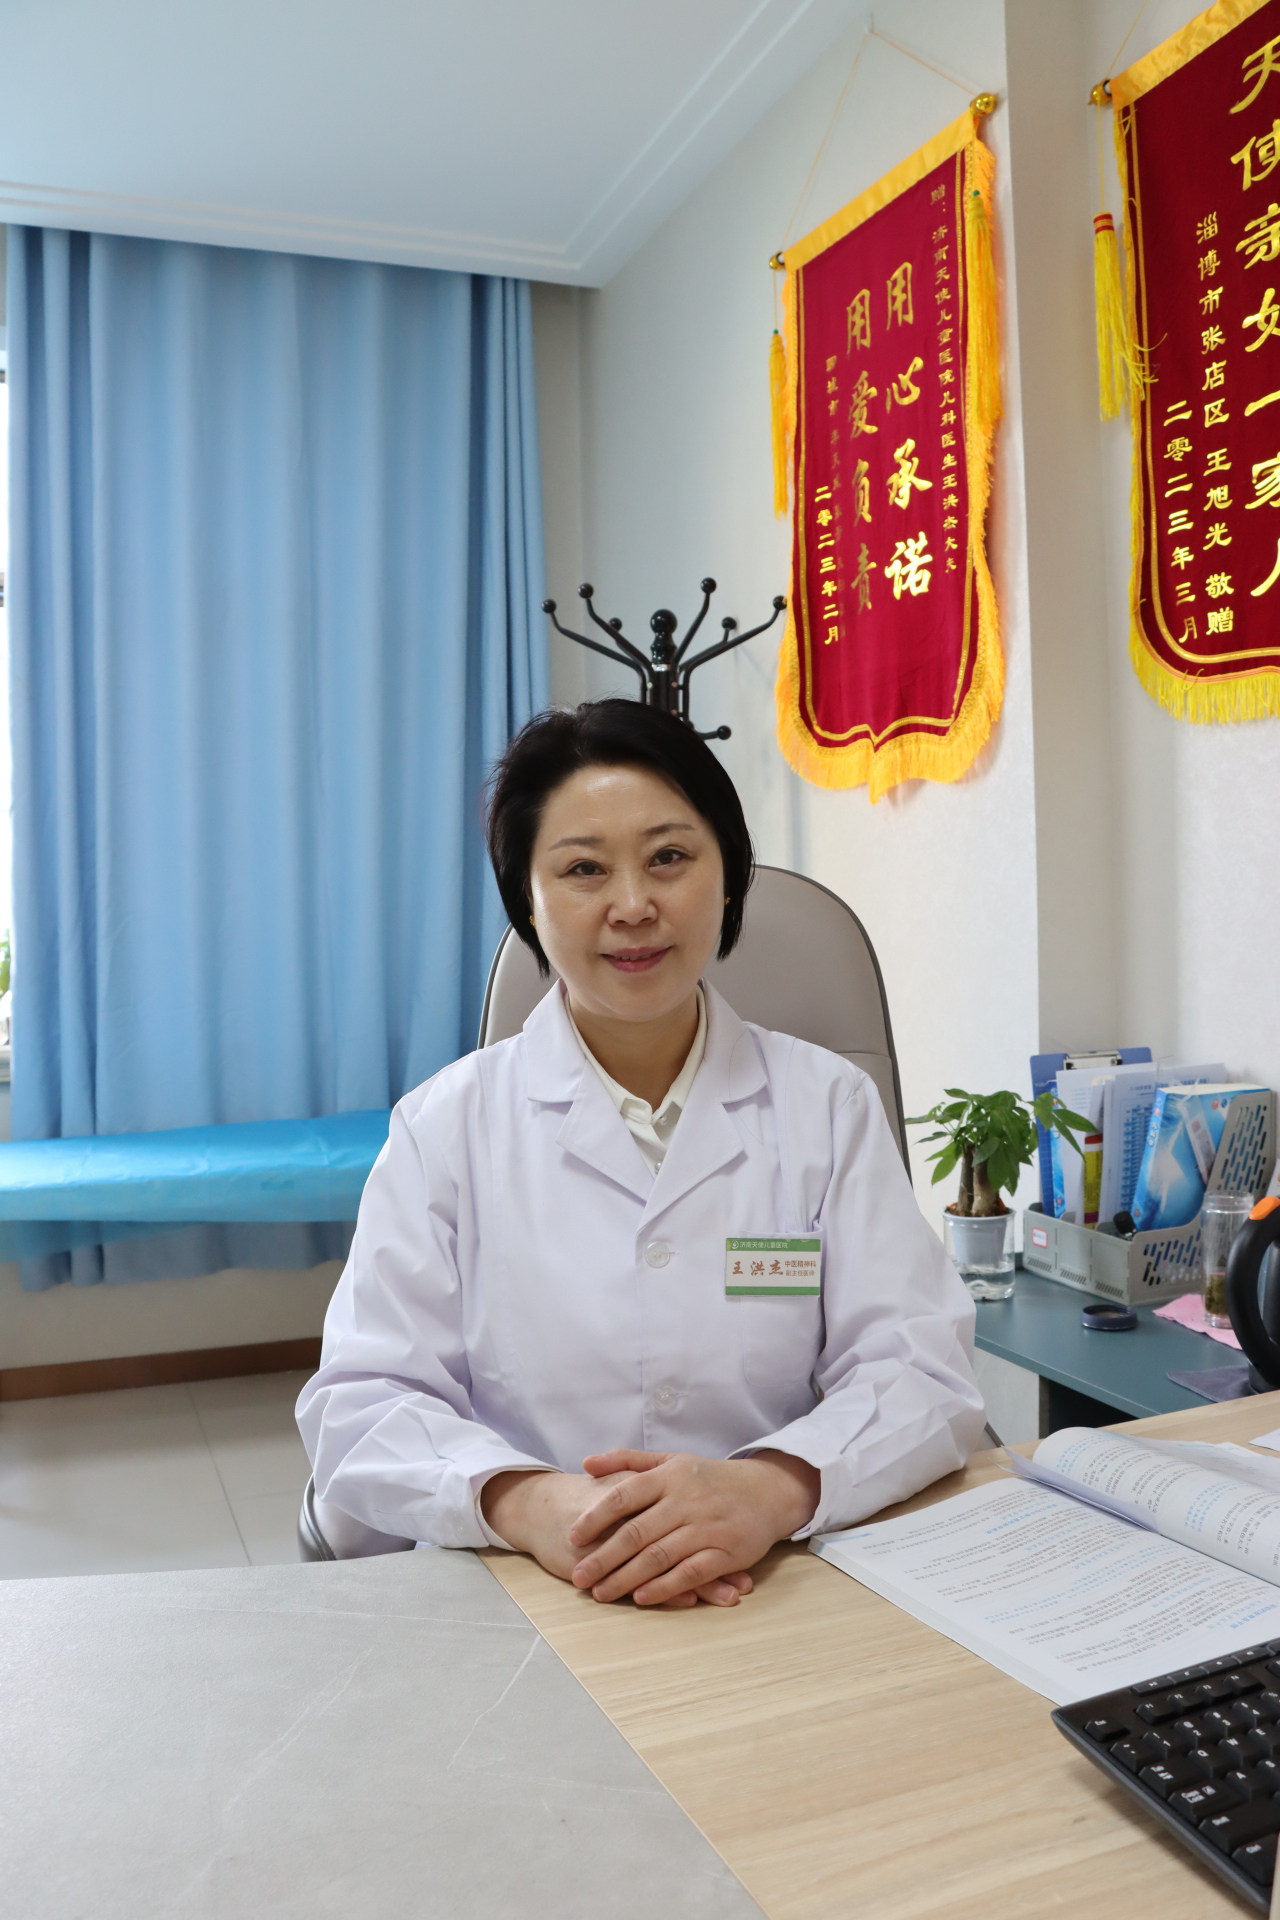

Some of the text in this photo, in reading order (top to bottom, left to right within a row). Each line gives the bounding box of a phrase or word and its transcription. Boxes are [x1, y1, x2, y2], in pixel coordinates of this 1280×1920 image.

[845, 287, 880, 614] 用爱负责
[883, 260, 933, 601] 用心承诺
[1195, 210, 1236, 636] 淄博市张店区 王旭光 敬赠
[813, 484, 840, 645] 二零二三年二月
[1160, 399, 1199, 646] 二零二三年三月
[732, 1259, 784, 1276] 王洪杰
[740, 1241, 788, 1249] 济南天使儿童医院
[784, 1260, 817, 1268] 中医精神科
[785, 1269, 815, 1277] 副主任医师
[1226, 1738, 1239, 1746] W
